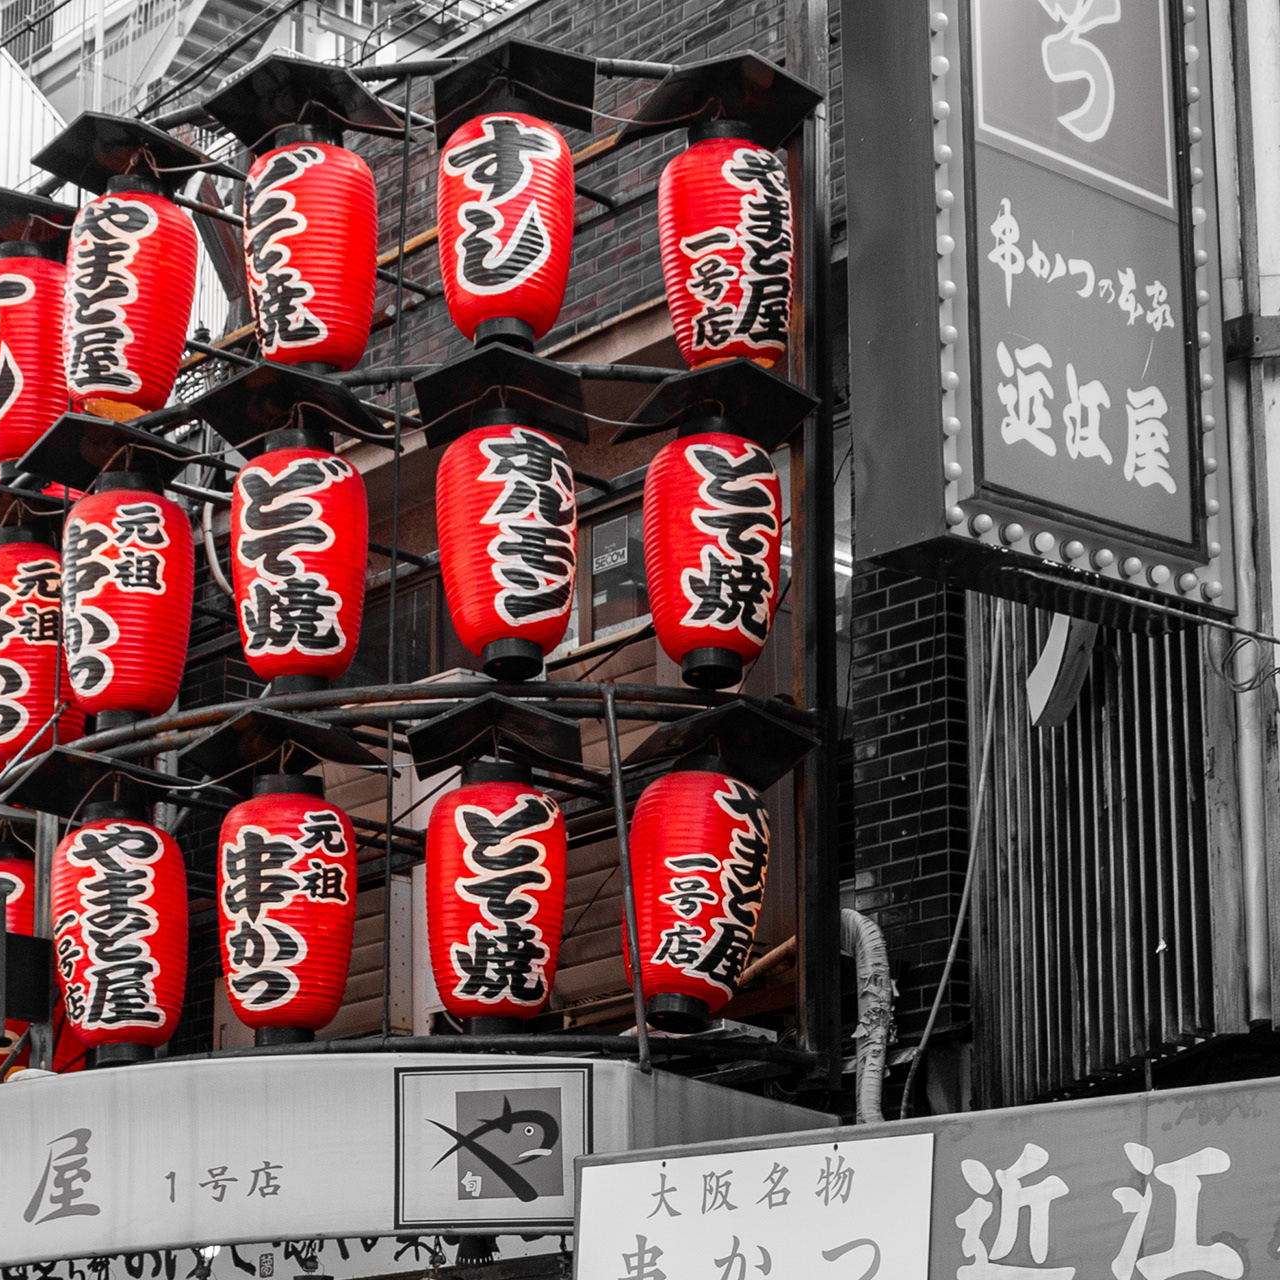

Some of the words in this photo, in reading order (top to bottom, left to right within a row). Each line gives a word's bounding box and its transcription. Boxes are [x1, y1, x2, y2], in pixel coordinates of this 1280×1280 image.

[449, 120, 560, 288] すし
[730, 152, 789, 341] やまと屋
[71, 202, 153, 390] やまと屋
[686, 233, 732, 347] 一号店
[997, 341, 1176, 494] 近江屋
[18, 561, 61, 642] 元祖
[119, 505, 163, 591] 元祖
[242, 459, 348, 652] どて焼
[595, 549, 625, 569] SECOM
[687, 445, 776, 642] どて焼
[227, 832, 304, 1006] 串かつ
[301, 815, 348, 901] 元祖
[455, 797, 558, 1000] どて焼
[660, 857, 718, 966] 一号店
[700, 782, 770, 985] やまと屋
[54, 913, 85, 1022] 一号店
[72, 828, 164, 1025] やまと屋
[164, 1160, 284, 1203] 1号店
[460, 1170, 482, 1197] 旬
[650, 1155, 855, 1218] 大阪名物
